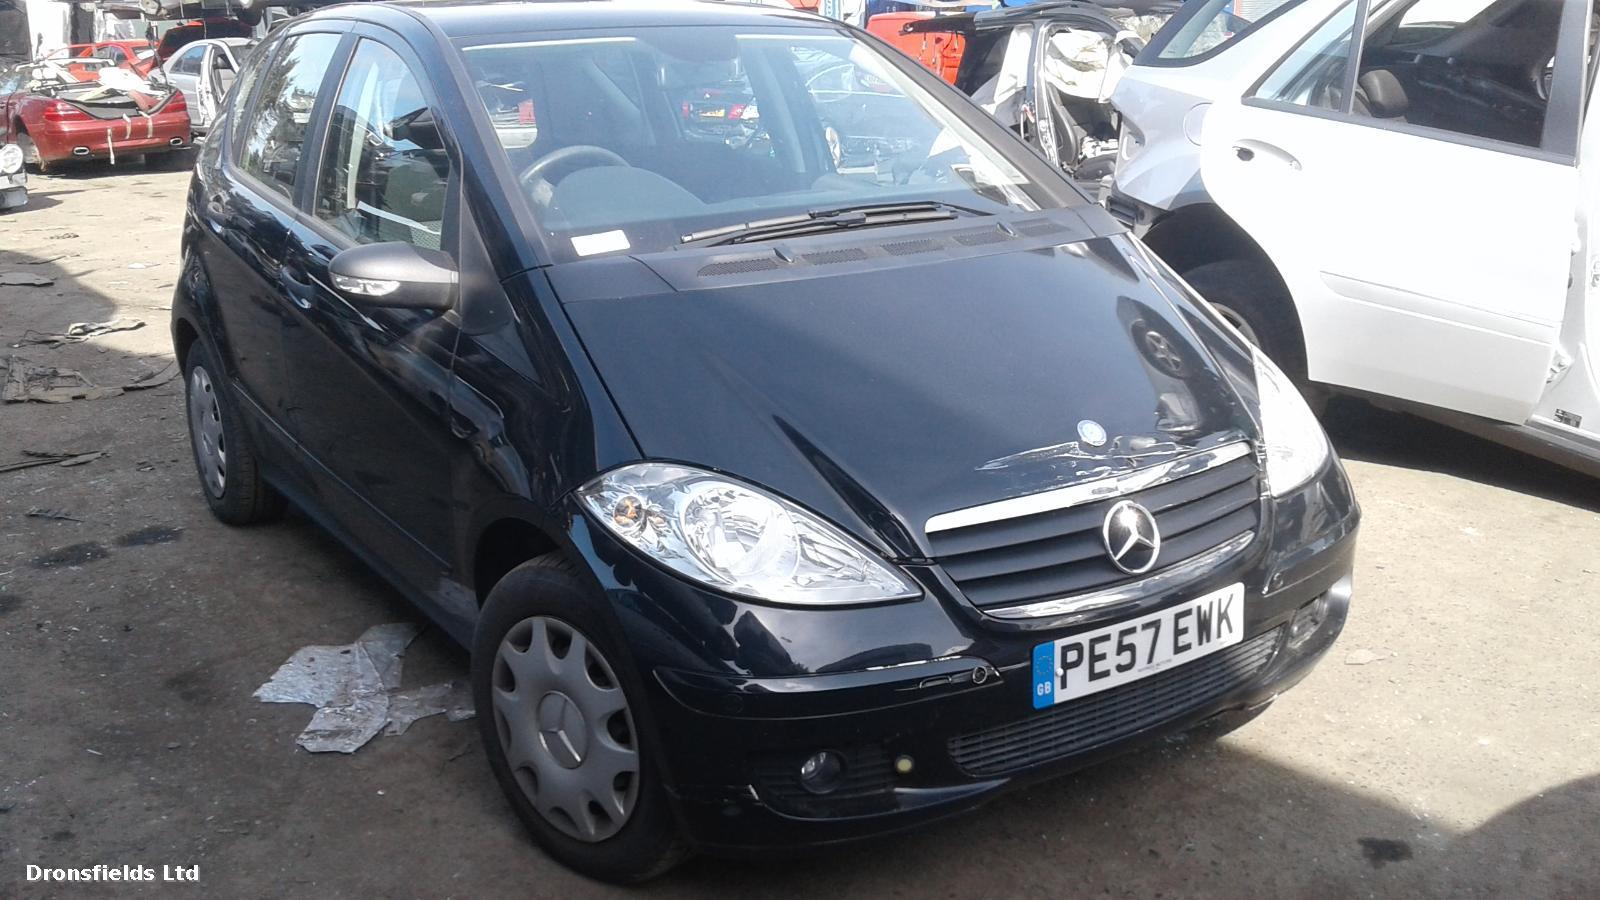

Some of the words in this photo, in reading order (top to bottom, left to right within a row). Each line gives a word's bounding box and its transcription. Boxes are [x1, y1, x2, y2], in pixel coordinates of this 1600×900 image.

[1060, 619, 1162, 690] PE57
[1173, 594, 1234, 655] EWK
[1037, 681, 1052, 696] GB
